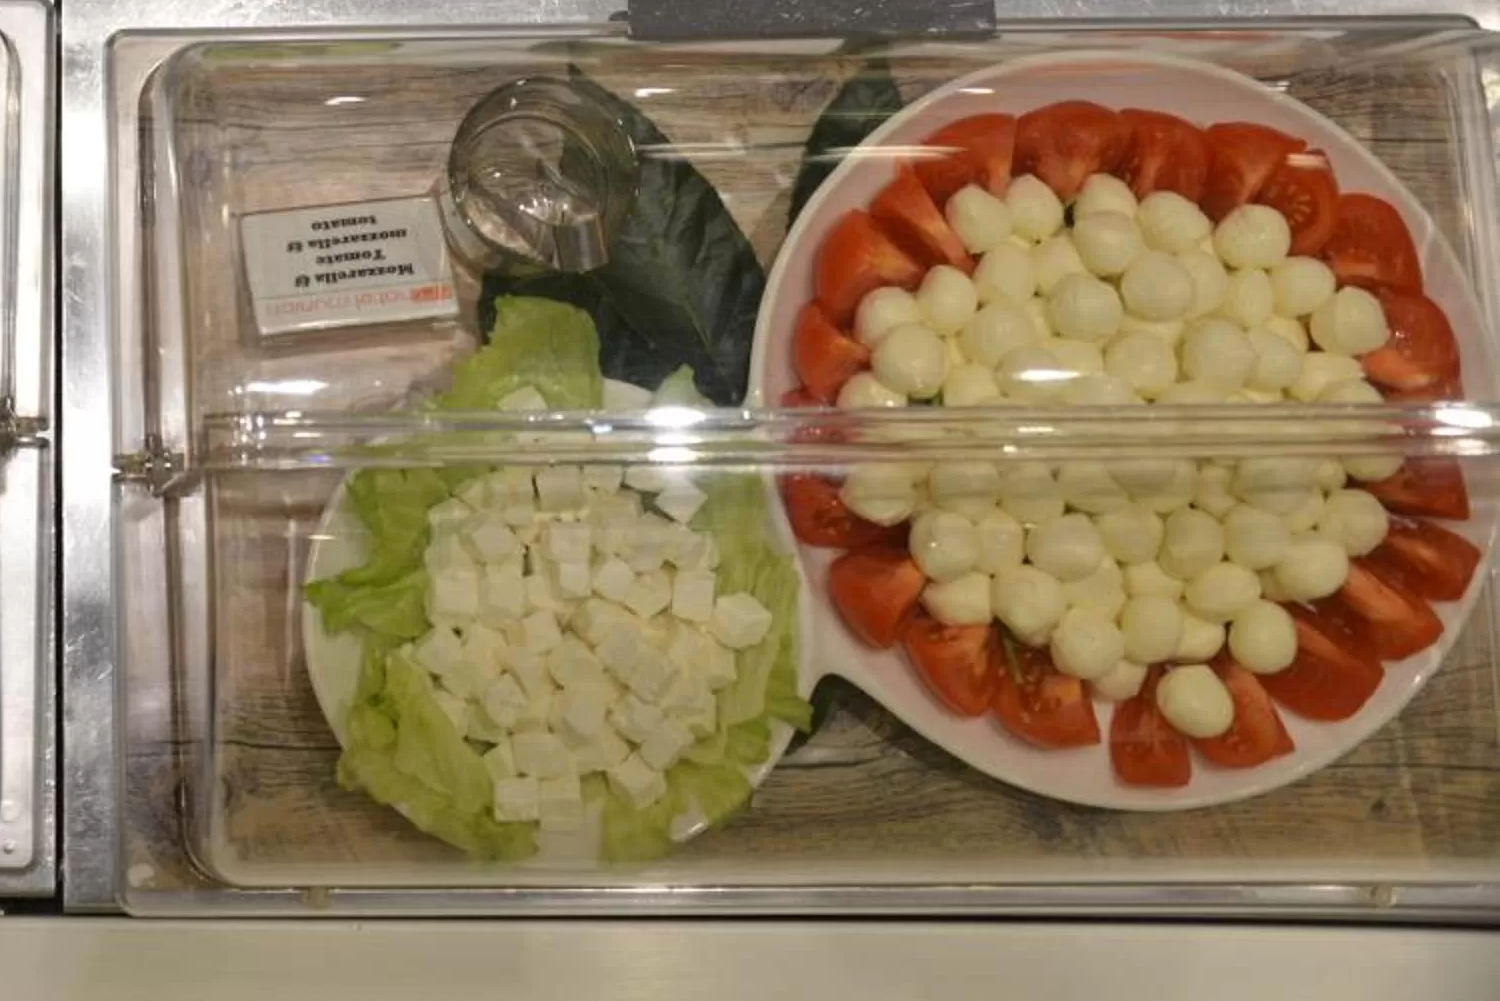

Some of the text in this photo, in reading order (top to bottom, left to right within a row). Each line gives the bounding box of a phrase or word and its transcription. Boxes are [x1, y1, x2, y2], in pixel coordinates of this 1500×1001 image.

[311, 214, 377, 231] tomato
[307, 228, 407, 250] mozzarella
[315, 249, 386, 265] Tomate
[315, 263, 415, 284] Mozzarella
